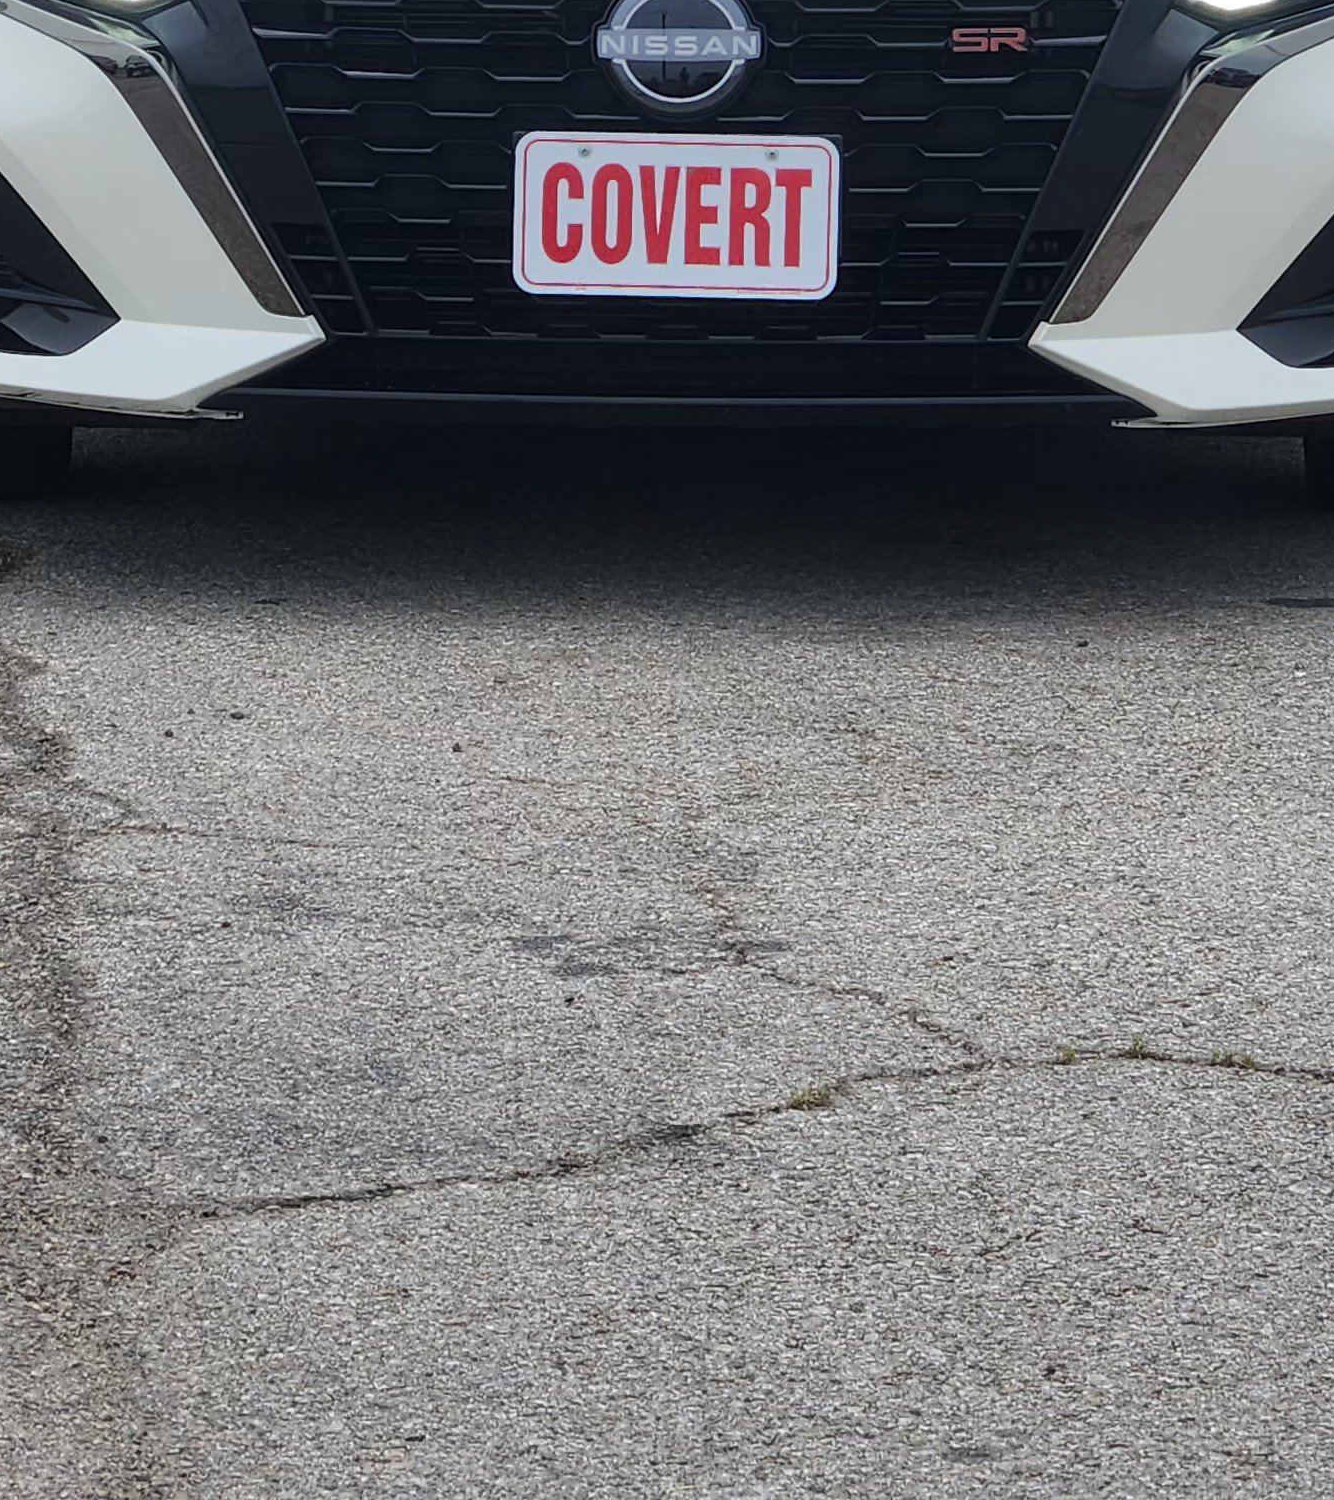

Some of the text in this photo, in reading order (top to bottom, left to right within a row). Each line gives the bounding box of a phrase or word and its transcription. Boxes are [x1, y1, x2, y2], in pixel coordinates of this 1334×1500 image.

[600, 34, 758, 57] NISSAN
[952, 27, 1028, 52] SR
[541, 161, 812, 268] COVERT
